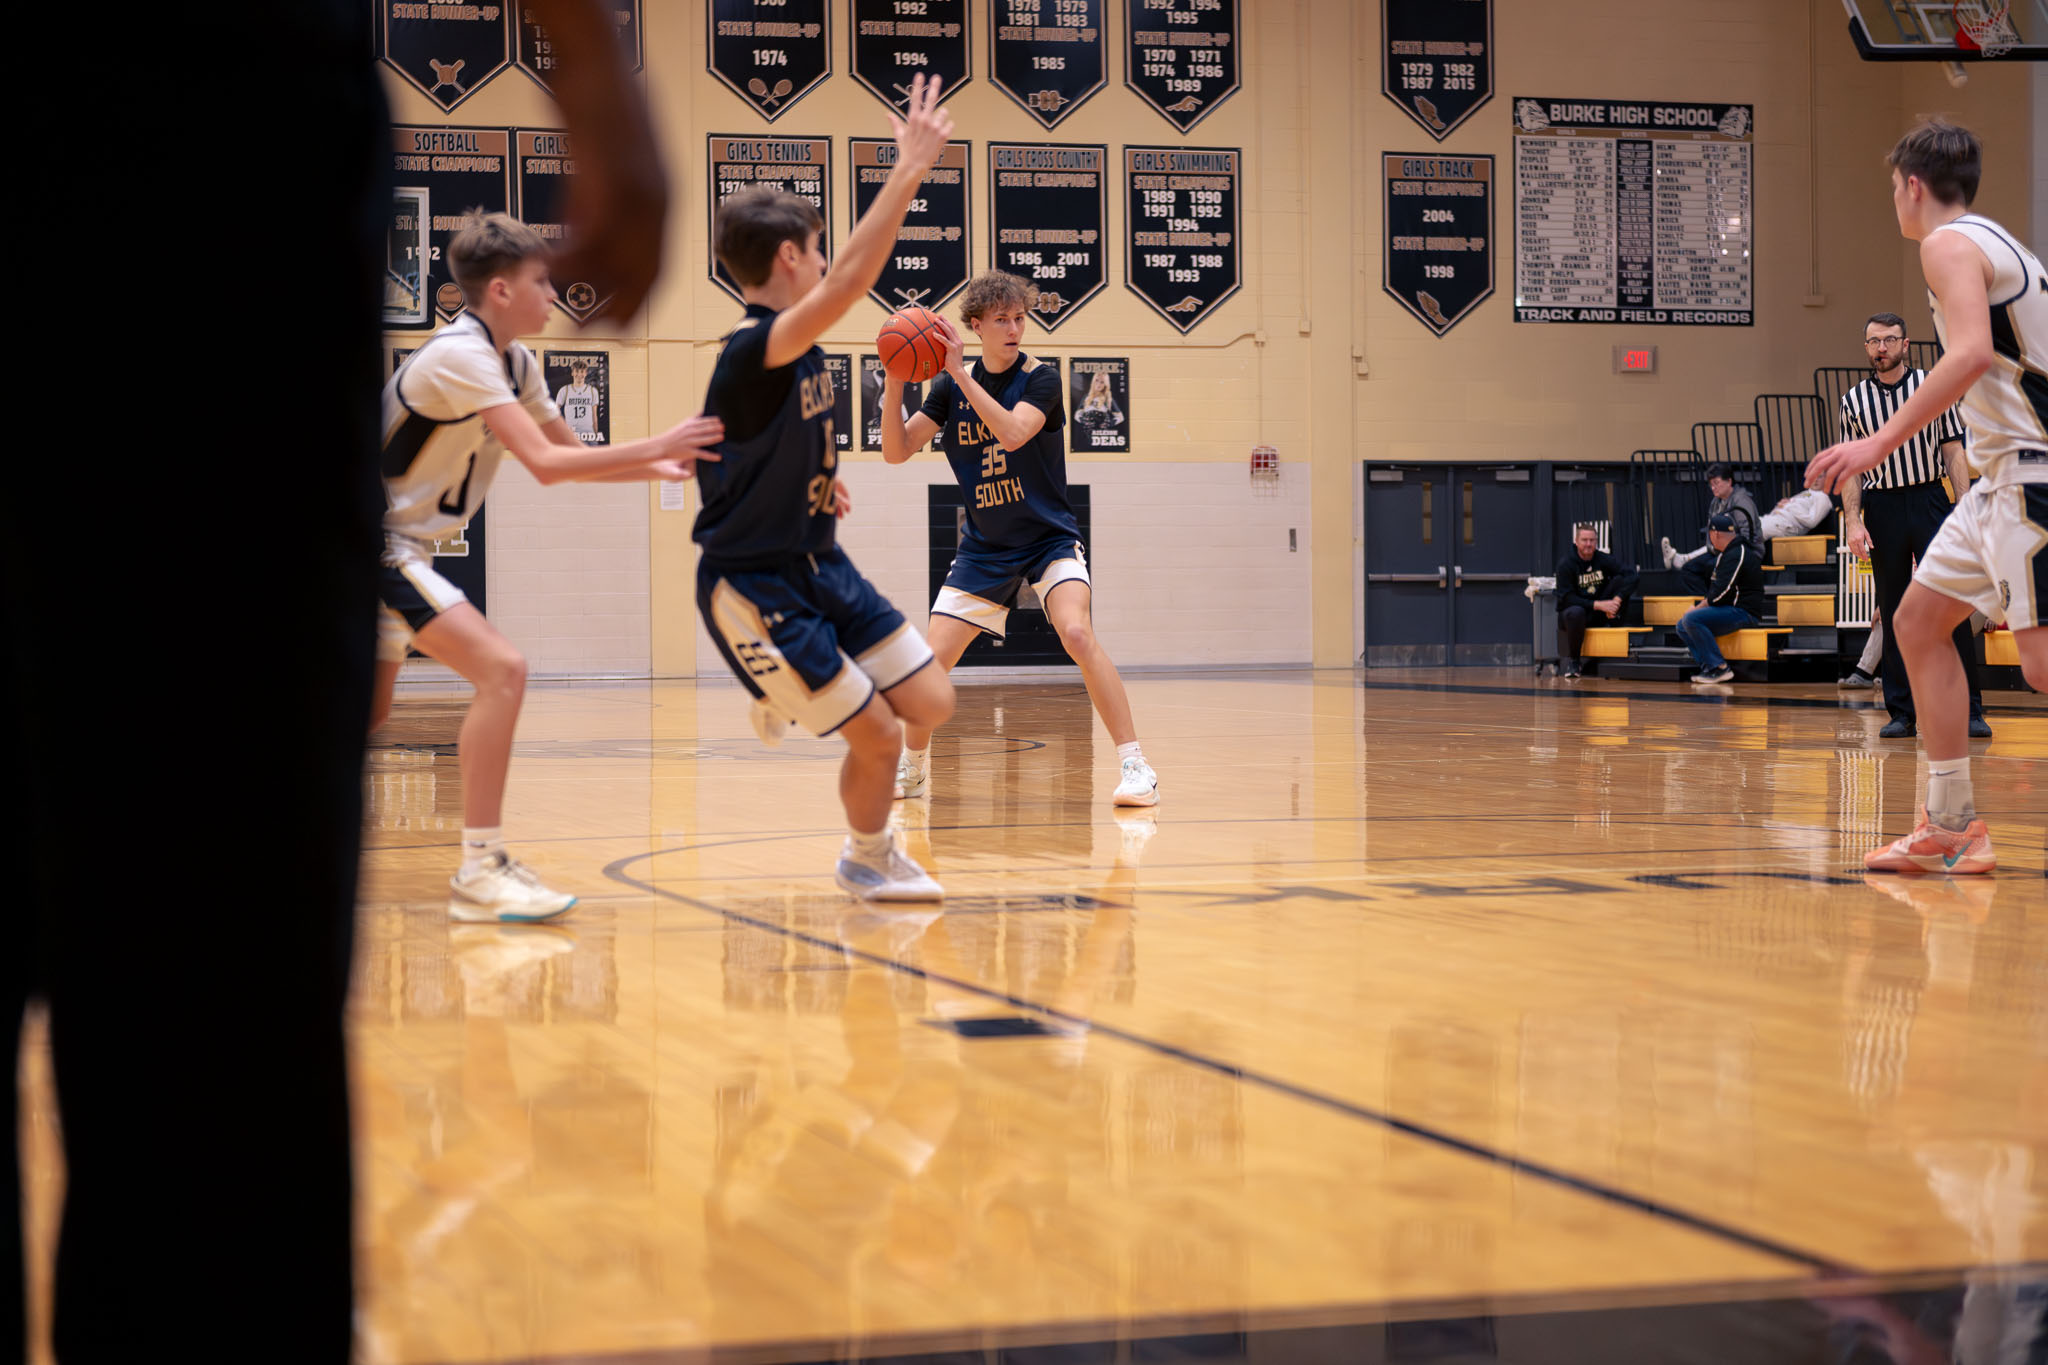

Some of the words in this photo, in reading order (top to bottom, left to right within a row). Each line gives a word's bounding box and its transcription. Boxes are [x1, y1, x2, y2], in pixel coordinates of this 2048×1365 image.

[392, 4, 428, 19] STATE
[431, 5, 500, 21] RUNNER-UP
[893, 2, 927, 15] 1992
[1007, 0, 1041, 11] 1978
[1055, 0, 1088, 12] 1979
[1007, 12, 1040, 26] 1981
[1055, 14, 1088, 27] 1983
[1166, 11, 1199, 24] 1995
[717, 21, 753, 36] STATE
[754, 21, 821, 38] RUNNER-UP
[860, 21, 895, 36] STATE
[896, 21, 961, 38] RUNNER-UP
[999, 26, 1033, 41] STATE
[1034, 27, 1097, 43] RUNNER-UP
[1134, 31, 1167, 45] STATE
[1169, 31, 1230, 46] RUNNER-UP
[1391, 41, 1423, 55] STATE
[753, 50, 788, 66] 1974
[893, 52, 928, 66] 1994
[1143, 49, 1176, 62] 1970
[1189, 50, 1221, 63] 1971
[1032, 57, 1065, 70] 1985
[1401, 63, 1433, 75] 1979
[1443, 64, 1475, 76] 1982
[1143, 64, 1176, 77] 1974
[1187, 65, 1223, 78] 1986
[1165, 79, 1201, 92] 1989
[1401, 77, 1433, 89] 1987
[1443, 78, 1475, 90] 2015
[1549, 104, 1605, 123] BURKE
[1609, 106, 1649, 124] HIGH
[1653, 107, 1718, 126] SCHOOL
[414, 132, 479, 152] SOFTBALL
[727, 142, 763, 161] GIRLS
[766, 143, 812, 161] TENNIS
[395, 155, 430, 171] STATE
[431, 156, 500, 172] CHAMPIONS
[526, 159, 561, 174] STATE
[997, 150, 1023, 168] GIRLS
[1025, 151, 1054, 168] CROSS
[1056, 151, 1098, 169] COUNTRY
[1133, 153, 1165, 171] GIRLS
[1169, 154, 1232, 172] SWIMMING
[719, 165, 753, 179] STATE
[755, 165, 820, 180] CHAMPIONS
[1402, 160, 1435, 177] GIRLS
[1438, 160, 1474, 178] TRACK
[794, 181, 820, 193] 1981
[999, 173, 1033, 187] STATE
[1033, 173, 1097, 188] CHAMPIONS
[1134, 175, 1167, 190] STATE
[1168, 176, 1230, 191] CHAMPIONS
[1392, 181, 1424, 195] STATE
[1143, 190, 1175, 203] 1989
[1189, 191, 1222, 203] 1990
[1143, 204, 1175, 217] 1991
[1190, 205, 1222, 218] 1992
[1422, 209, 1455, 223] 2004
[1166, 218, 1199, 232] 1994
[1000, 229, 1033, 243] STATE
[1035, 230, 1098, 244] RUNNER-UP
[1135, 232, 1168, 246] STATE
[1169, 232, 1232, 247] RUNNER-UP
[1392, 236, 1425, 250] STATE
[895, 257, 929, 270] 1993
[1009, 252, 1042, 265] 1986
[1057, 252, 1090, 265] 2001
[1144, 255, 1176, 267] 1987
[1190, 255, 1223, 268] 1988
[1032, 265, 1066, 279] 2003
[1168, 270, 1200, 282] 1993
[1423, 265, 1455, 278] 1998
[1517, 308, 1574, 320] TRACK
[1578, 310, 1616, 321] AND
[1621, 310, 1667, 323] FIELD
[1672, 311, 1751, 324] RECORDS
[1627, 351, 1649, 368] EXIT
[1073, 362, 1120, 373] BURKE
[574, 406, 586, 419] 13
[1091, 436, 1126, 446] DEAS
[981, 443, 1007, 478] 35
[975, 476, 1025, 509] SOUTH
